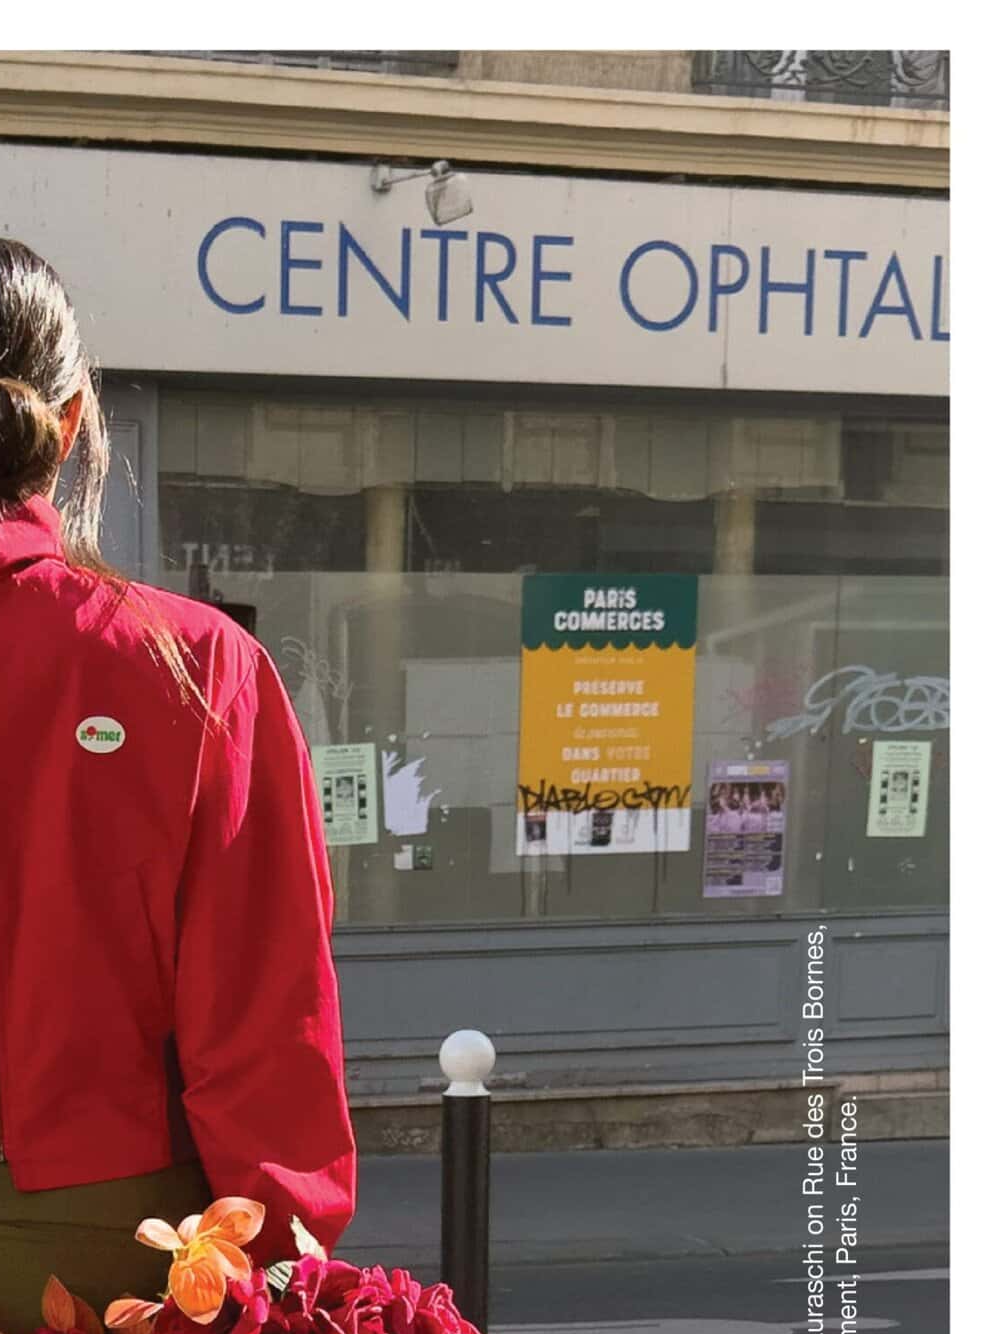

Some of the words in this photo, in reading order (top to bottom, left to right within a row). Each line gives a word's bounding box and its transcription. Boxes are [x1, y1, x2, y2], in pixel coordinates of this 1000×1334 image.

[197, 216, 575, 327] CENTRE
[619, 240, 950, 342] OPHTAL
[553, 611, 666, 631] COMMERCES
[556, 703, 573, 718] LE
[580, 702, 660, 718] COMMERCE
[562, 747, 600, 761] DANS
[571, 767, 641, 784] QUARTIER
